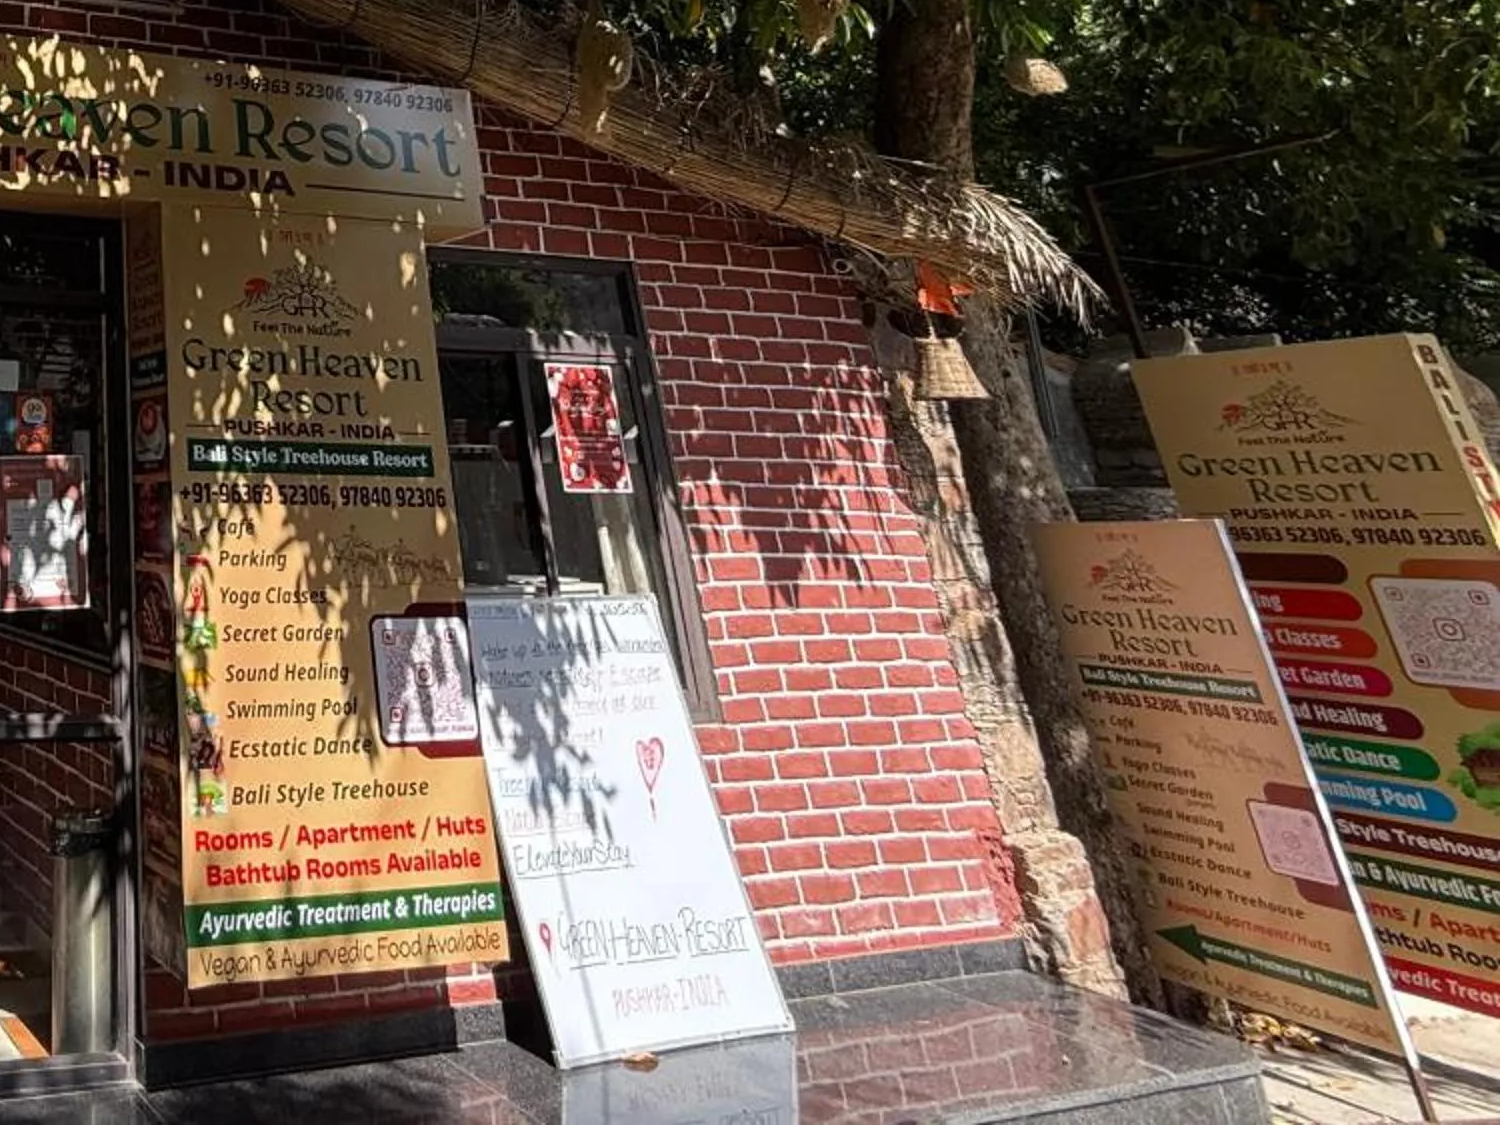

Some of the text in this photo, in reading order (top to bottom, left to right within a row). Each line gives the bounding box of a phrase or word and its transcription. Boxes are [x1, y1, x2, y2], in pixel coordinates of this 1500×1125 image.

[353, 88, 402, 109] 97840
[404, 92, 454, 114] 92306
[231, 98, 461, 178] Resort
[163, 160, 296, 196] INDIA
[181, 338, 424, 382] Green Heaven
[251, 380, 368, 416] Resort
[224, 420, 396, 441] PUSHKAR INDIA
[192, 444, 428, 468] Bali Style Treehouse Resort
[1176, 448, 1444, 477] Green Heaven
[180, 482, 447, 510] +91-96363 52306, 97840 92306
[1248, 478, 1380, 504] Resort
[217, 517, 256, 536] Café
[1230, 508, 1419, 522] PUSHKAR INDIA
[1352, 527, 1415, 546] 97840
[1420, 528, 1486, 547] 92306
[217, 549, 288, 573] Parking
[219, 586, 328, 610] Yoga Classes
[222, 623, 345, 643] Secret Garden
[1061, 603, 1239, 636] Green Heaven
[1109, 628, 1200, 657] Resort
[225, 662, 350, 686] Sound Healing
[1300, 666, 1366, 690] Garden
[226, 697, 358, 723] Swimming Pool
[1313, 705, 1388, 732] Healing
[228, 735, 374, 760] Ecstatic Dance
[1343, 744, 1402, 770] Dance
[232, 778, 430, 807] Bali Style Treehouse
[1380, 785, 1428, 812] Pool
[194, 826, 274, 852] Rooms
[296, 820, 417, 851] Apartment
[436, 814, 487, 837] Huts
[1339, 818, 1390, 843] Style
[206, 849, 483, 887] Bathtub Rooms Available
[1384, 864, 1480, 902] Ayurvedic
[199, 889, 497, 936] Ayurvedic Treatment & Therapies
[199, 927, 501, 982] Vegan & Ayurvedic Food Available
[1376, 927, 1444, 957] thtub
